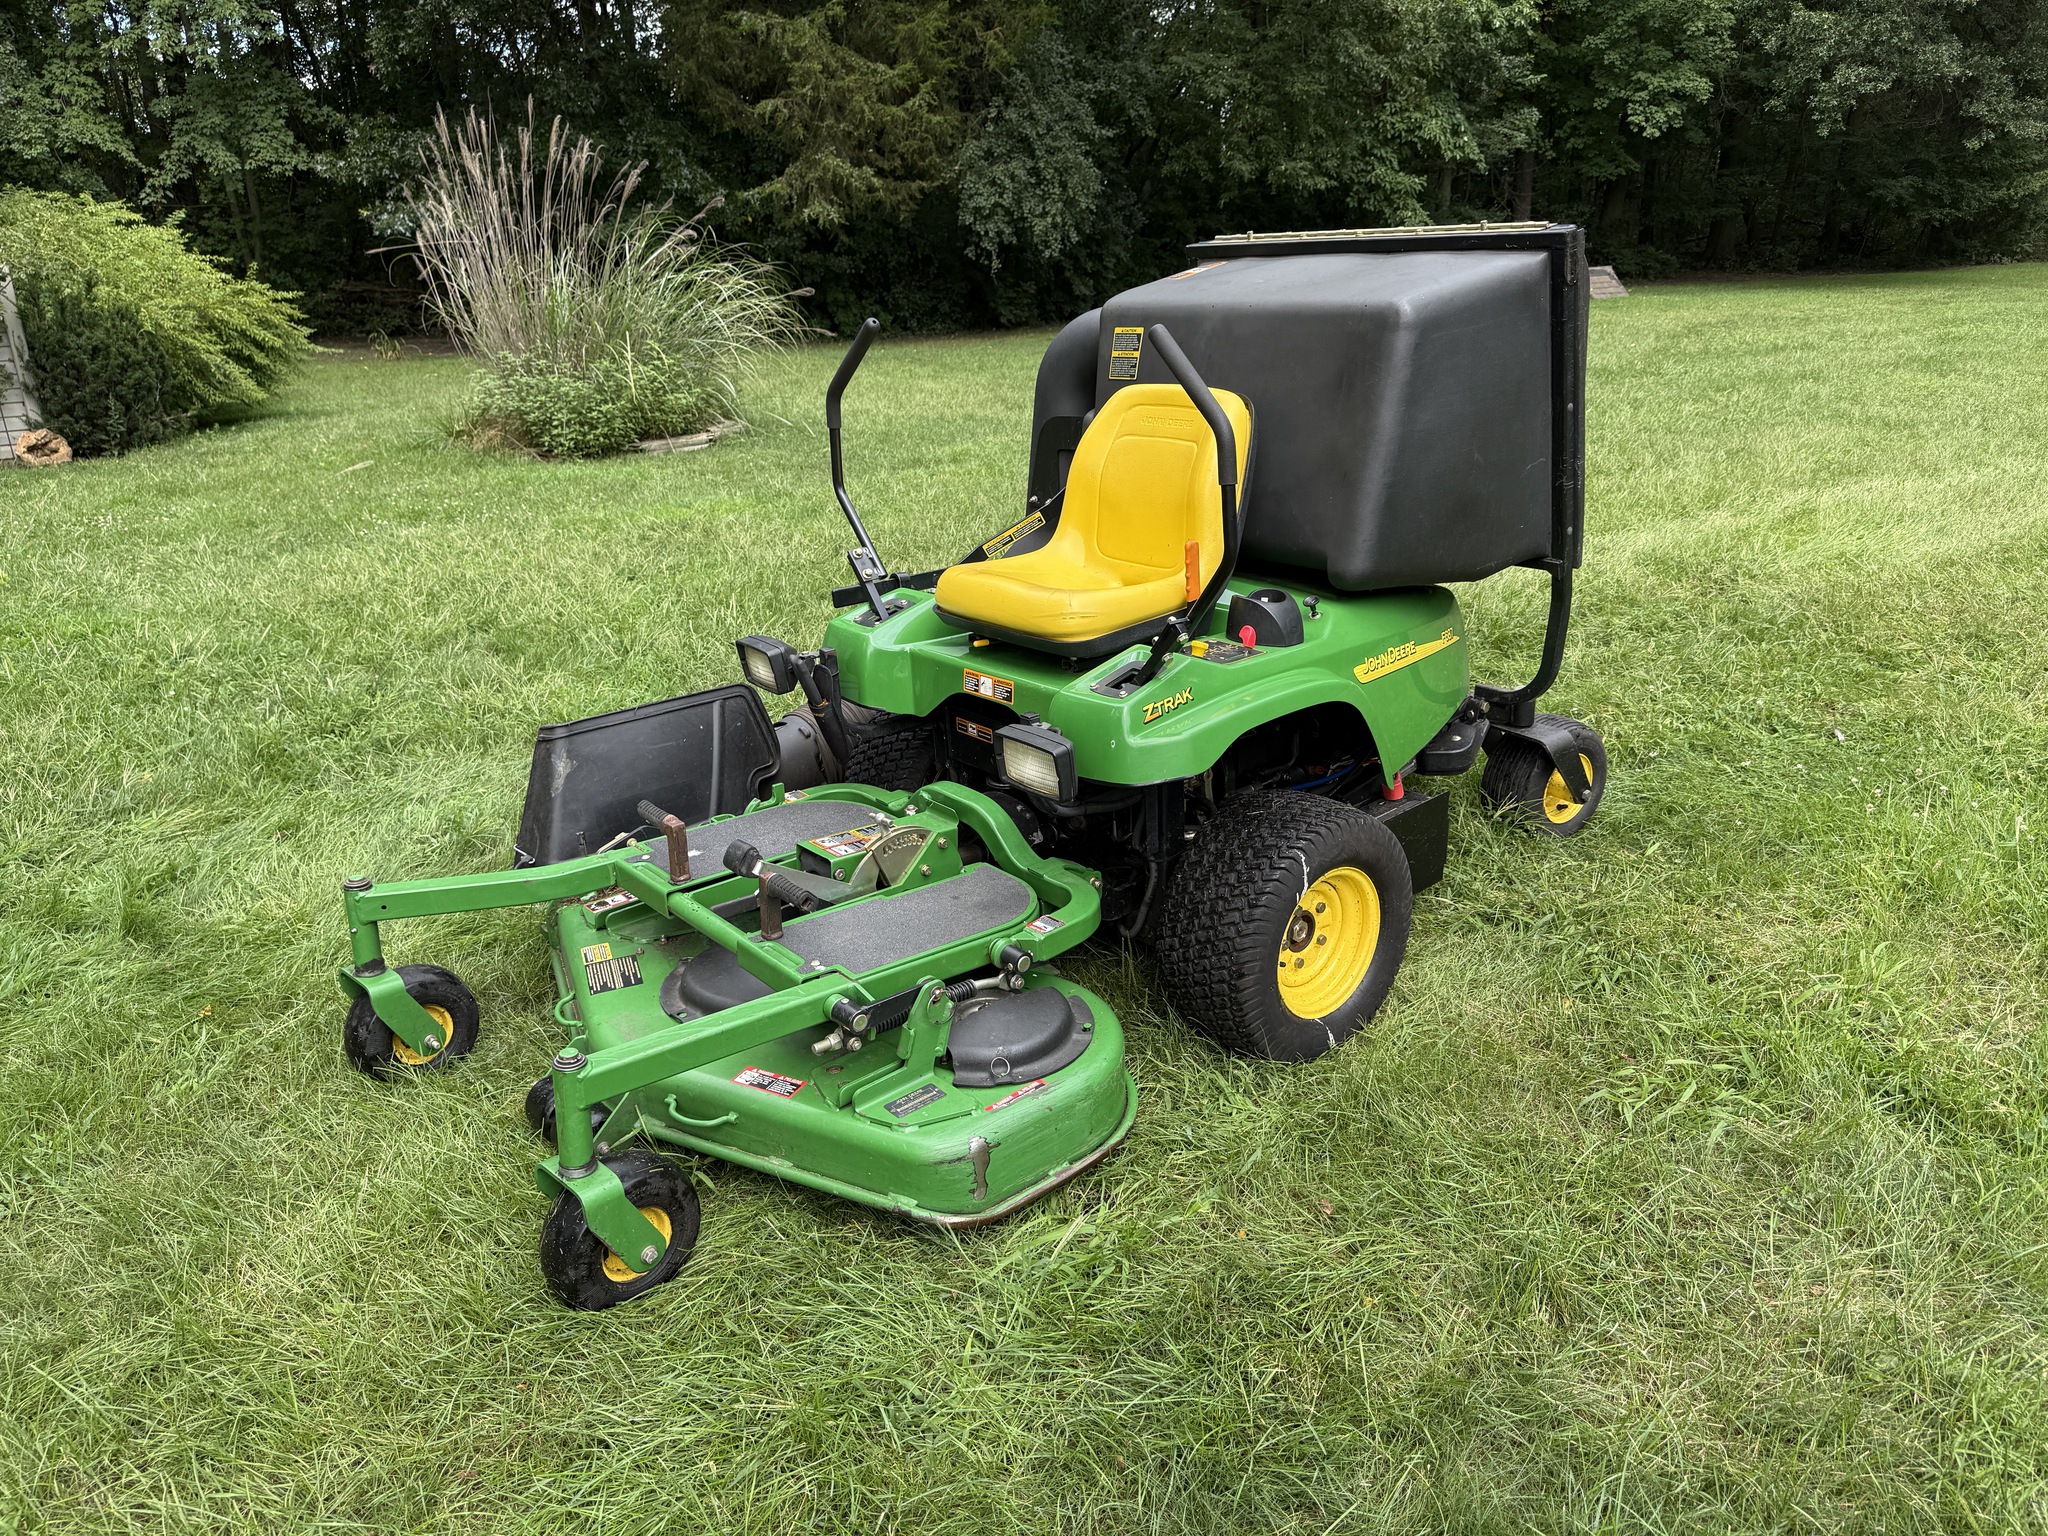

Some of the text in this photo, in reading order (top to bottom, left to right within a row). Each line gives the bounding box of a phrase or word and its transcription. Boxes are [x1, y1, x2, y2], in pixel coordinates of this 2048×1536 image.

[1140, 415, 1194, 429] JOHN DEERE
[1142, 686, 1194, 725] ZTRAK
